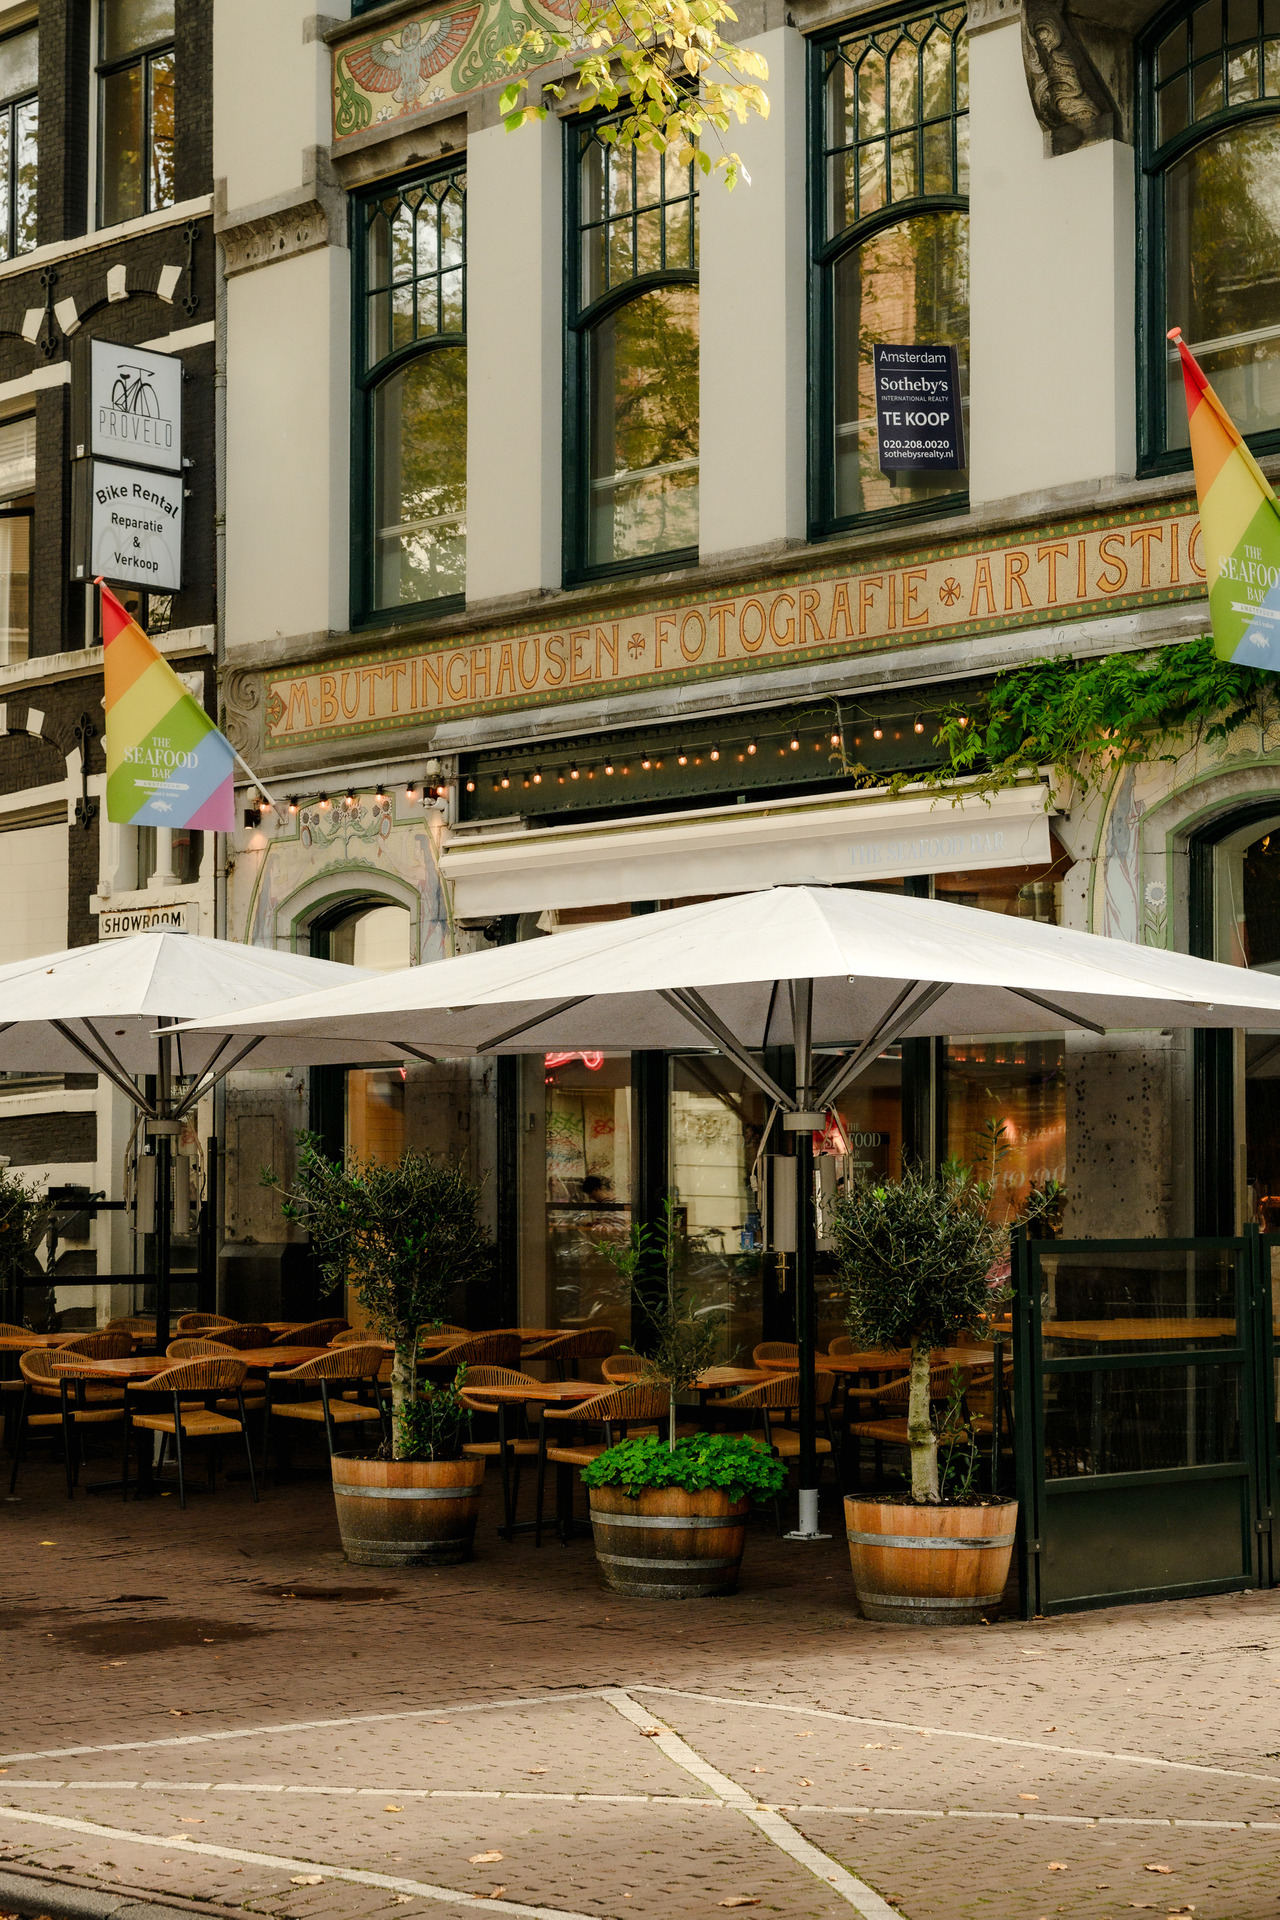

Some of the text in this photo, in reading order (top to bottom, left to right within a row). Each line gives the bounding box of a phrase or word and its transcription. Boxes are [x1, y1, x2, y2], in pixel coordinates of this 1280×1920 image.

[880, 351, 947, 363] Amsterdam
[880, 376, 949, 394] Sotheby's
[882, 411, 950, 426] TE KOOP
[99, 410, 172, 447] PROVELO
[883, 440, 950, 449] 020.208.0020
[884, 450, 954, 459] sothebysrealty.nl
[95, 483, 179, 519] Bike Rental
[111, 512, 163, 533] Reparatie
[133, 536, 141, 548] &
[1244, 544, 1263, 561] THE
[114, 551, 159, 573] Verkoop
[1218, 555, 1280, 590] SEAFOO
[1247, 586, 1266, 603] BAR
[654, 568, 929, 669] FOTOGRAFIE
[151, 736, 171, 748] THE
[123, 746, 199, 769] SEAFOOD
[151, 768, 172, 779] BAR
[848, 831, 1005, 866] THE SEAFOOD BAR
[104, 911, 181, 934] SHOWROOM
[846, 1122, 861, 1131] THE
